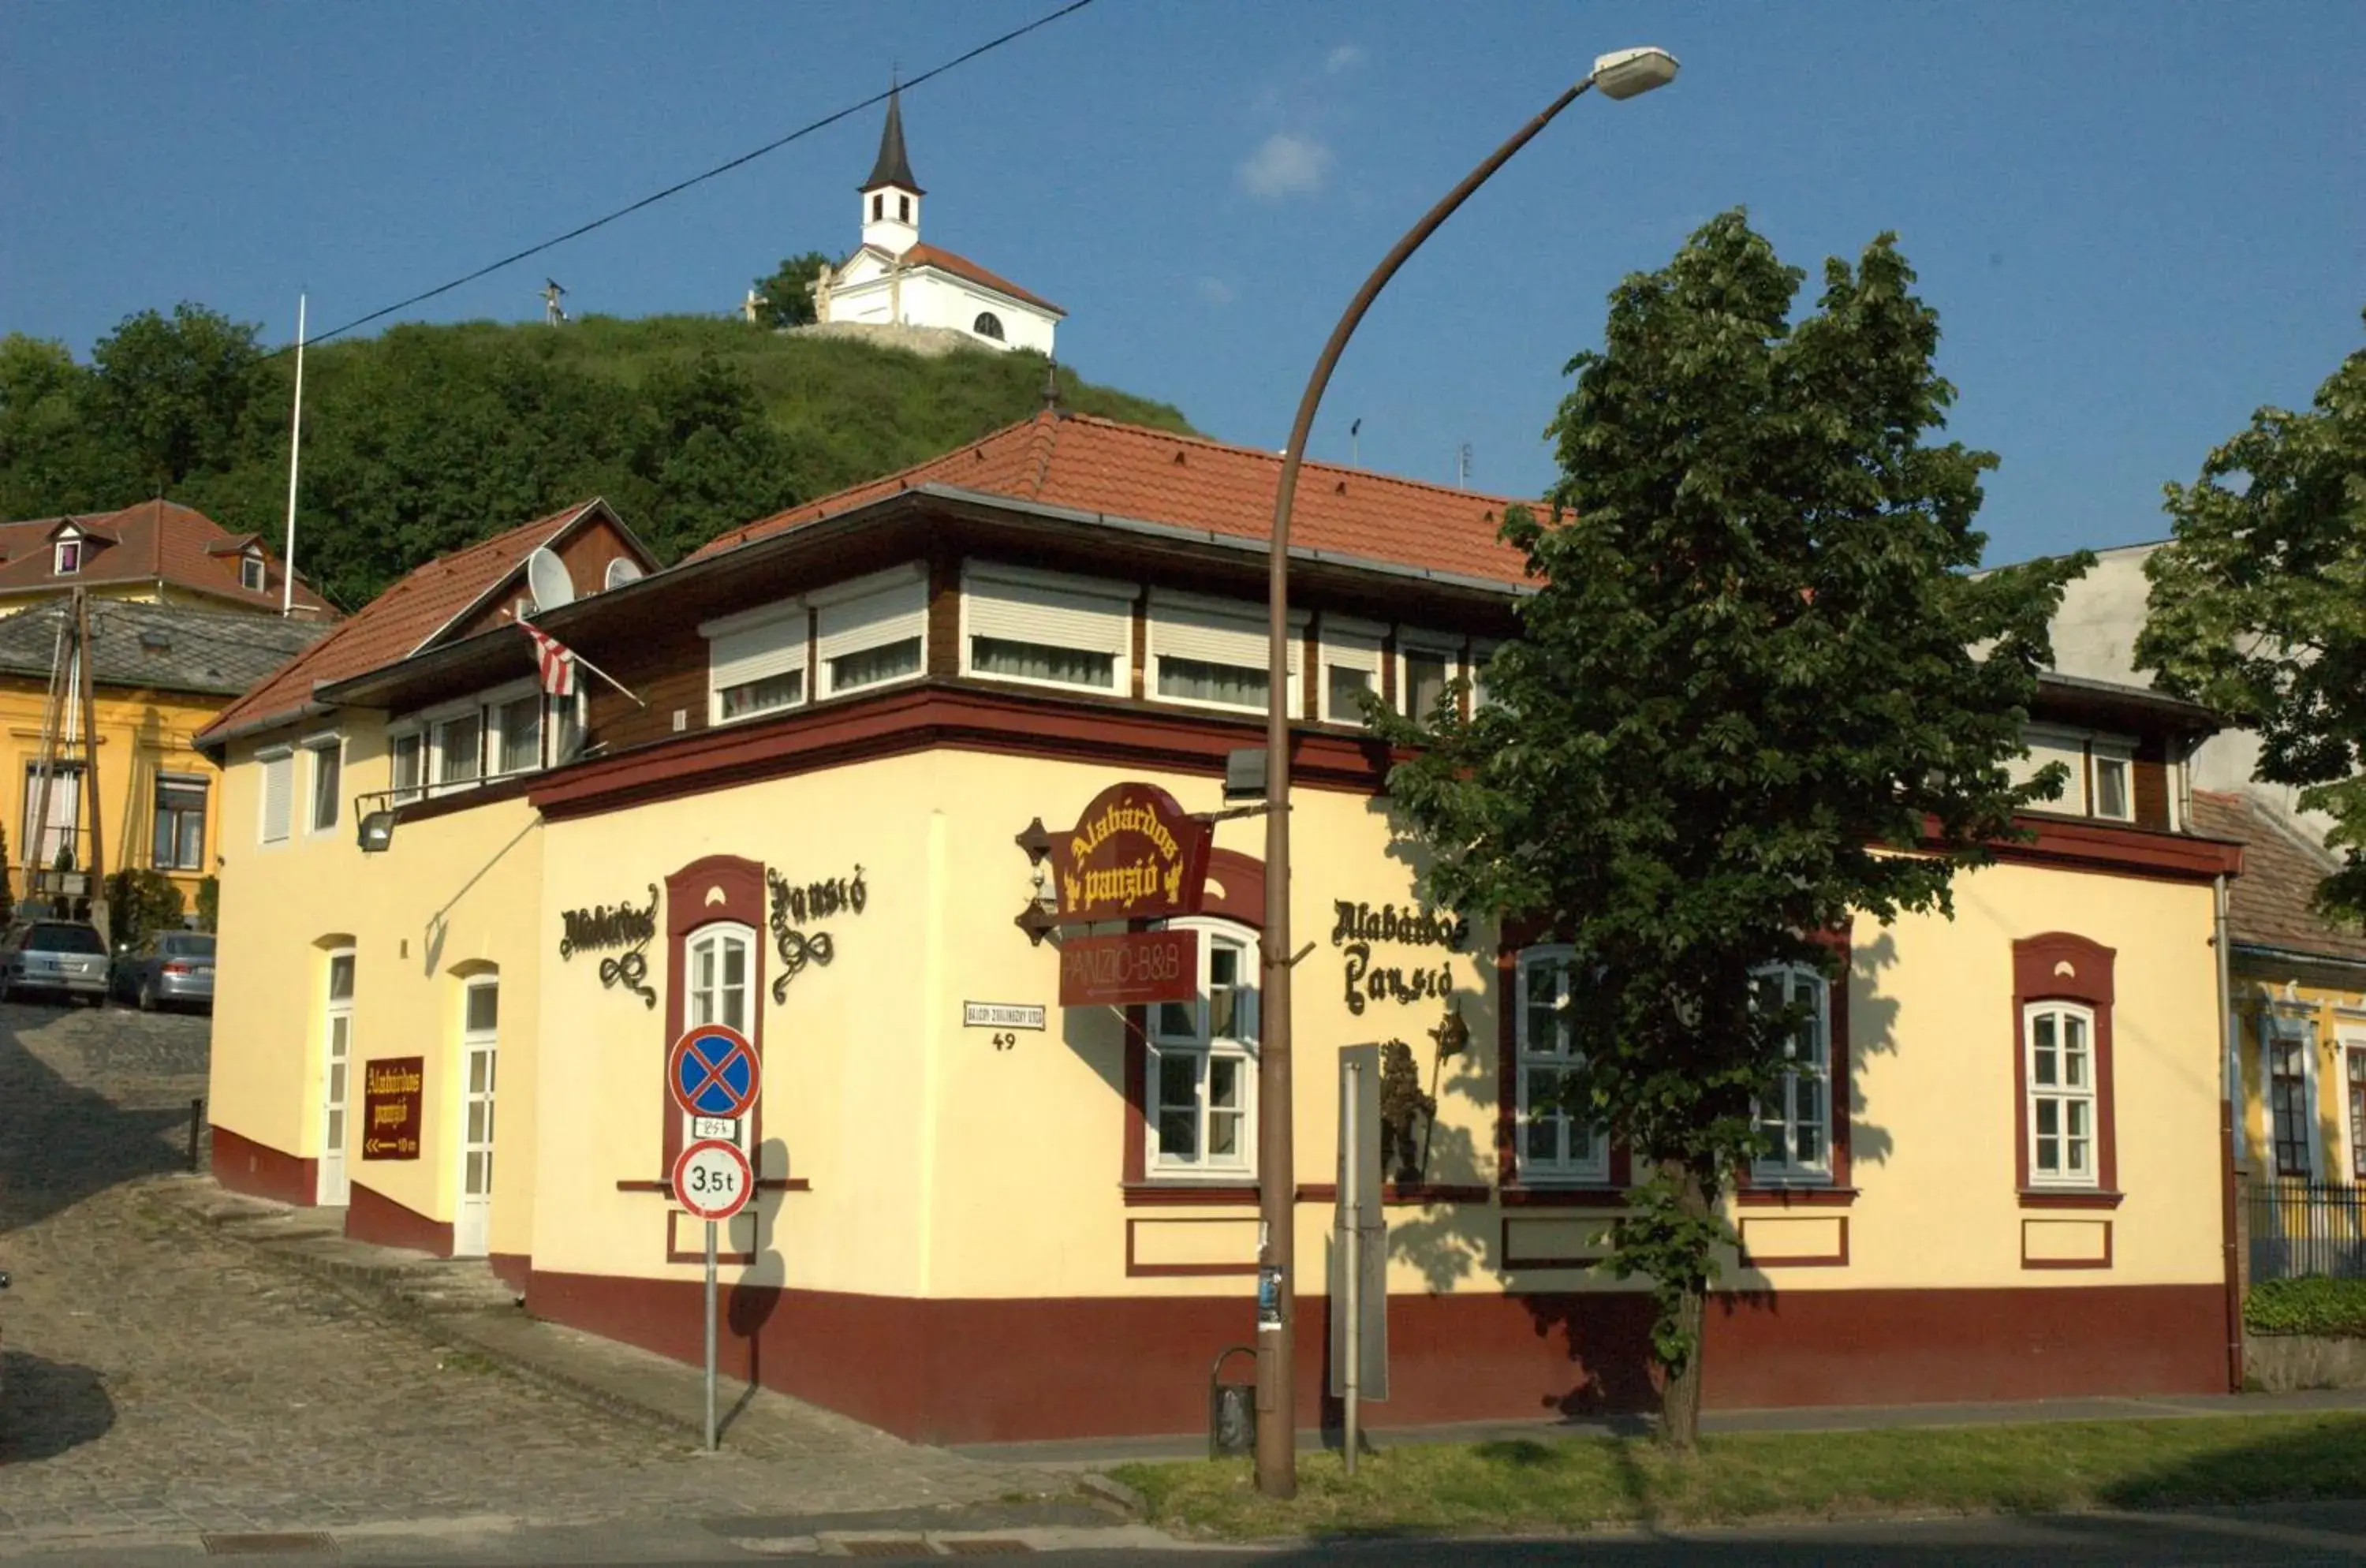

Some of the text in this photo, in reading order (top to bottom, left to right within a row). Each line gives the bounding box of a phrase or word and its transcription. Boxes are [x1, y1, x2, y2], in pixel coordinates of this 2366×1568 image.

[1071, 797, 1179, 873] Alabárdos
[1084, 852, 1159, 911] panzió
[1331, 898, 1468, 946] Alabárdos
[992, 1032, 1016, 1051] 49
